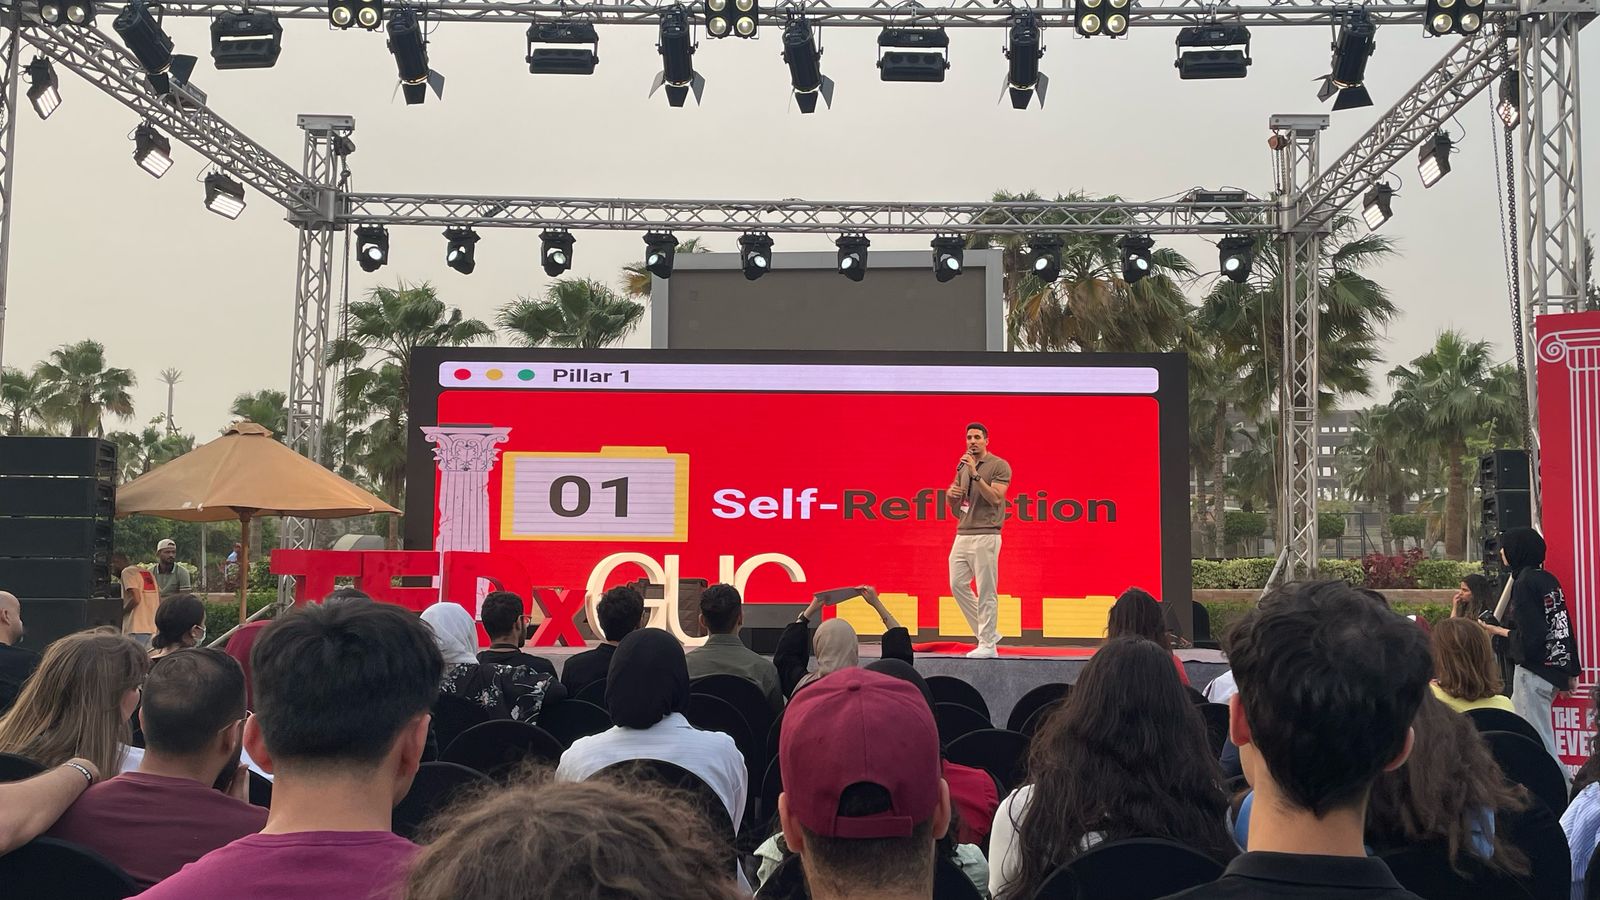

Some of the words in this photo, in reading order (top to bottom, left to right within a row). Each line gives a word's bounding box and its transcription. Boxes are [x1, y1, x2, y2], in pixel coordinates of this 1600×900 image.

[553, 369, 612, 383] Pillar
[620, 369, 630, 383] 1
[549, 475, 629, 518] 01
[1552, 706, 1580, 729] THE
